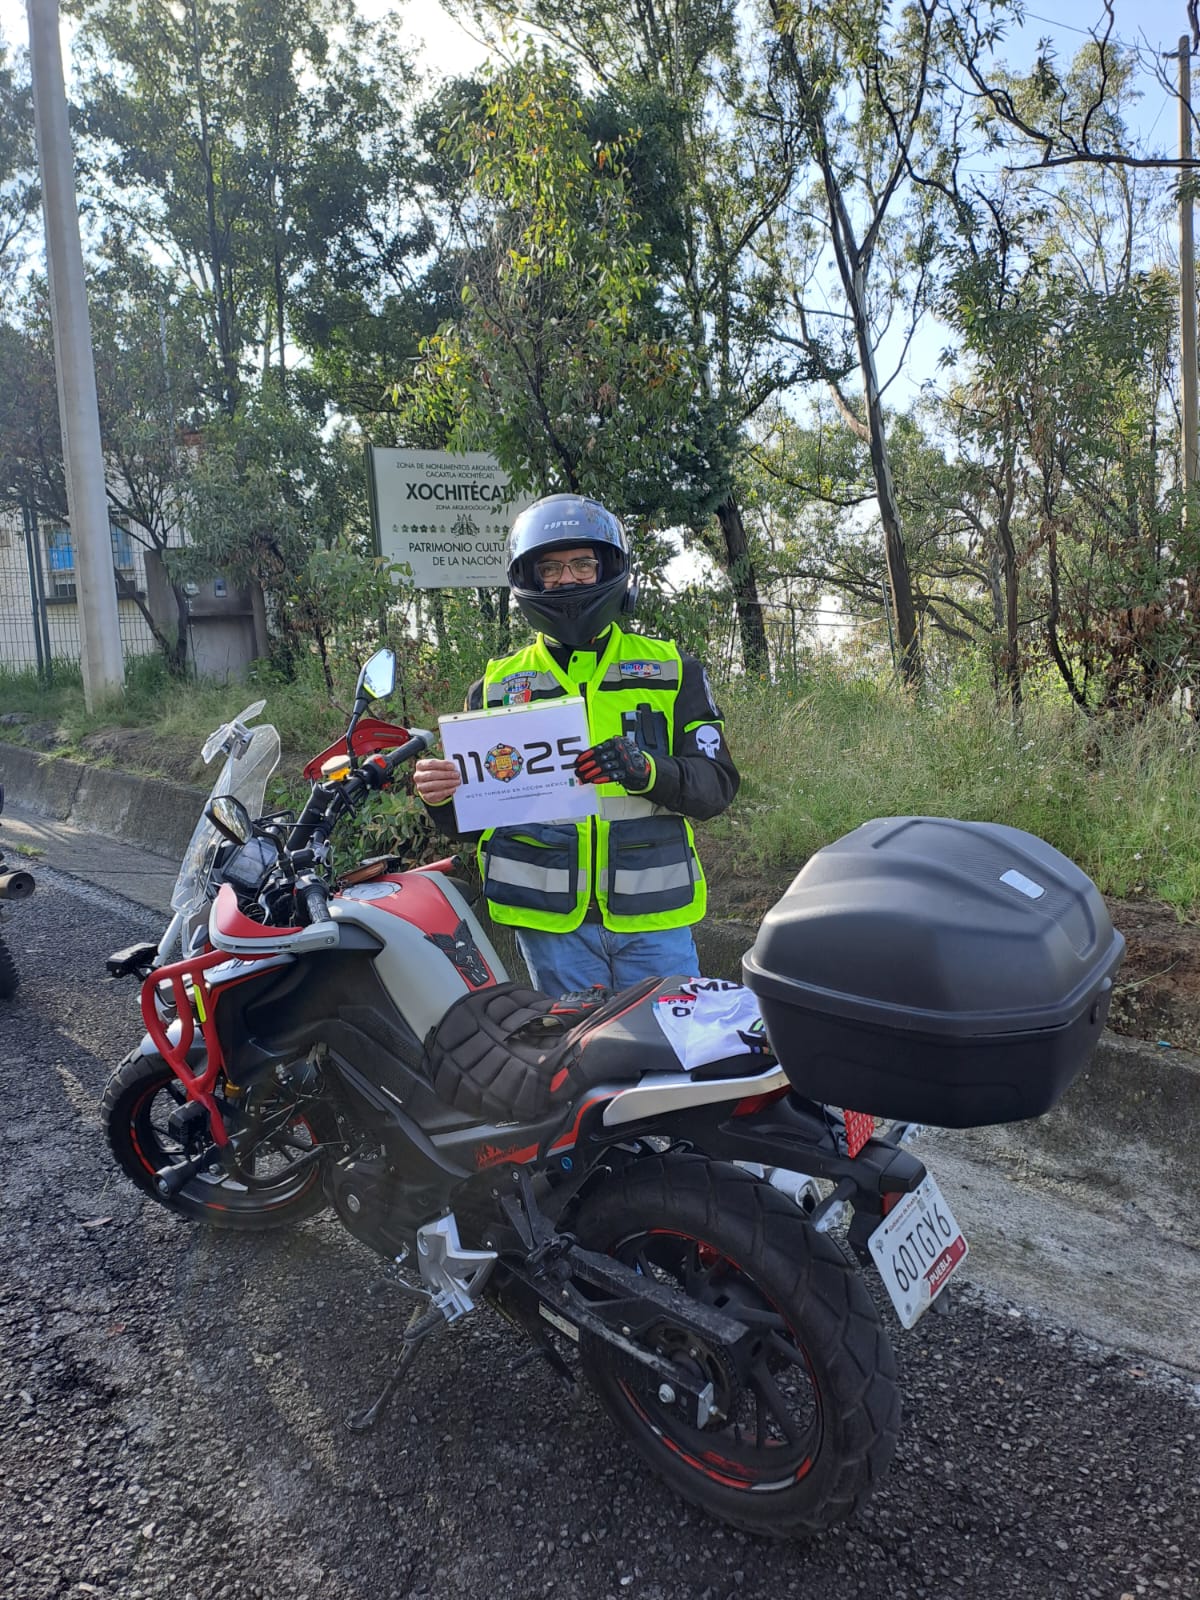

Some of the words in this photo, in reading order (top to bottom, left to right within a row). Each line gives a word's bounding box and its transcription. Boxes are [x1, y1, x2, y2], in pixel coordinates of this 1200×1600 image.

[416, 462, 424, 470] DE
[425, 463, 470, 471] MONUMENTOS
[408, 542, 473, 553] PATRIMONIO
[475, 542, 506, 553] CULTU
[432, 556, 446, 566] DE
[447, 556, 460, 566] LA
[461, 554, 502, 566] NACIÓN
[892, 1203, 951, 1292] 60TGY6
[929, 1253, 953, 1286] PUEBLA
